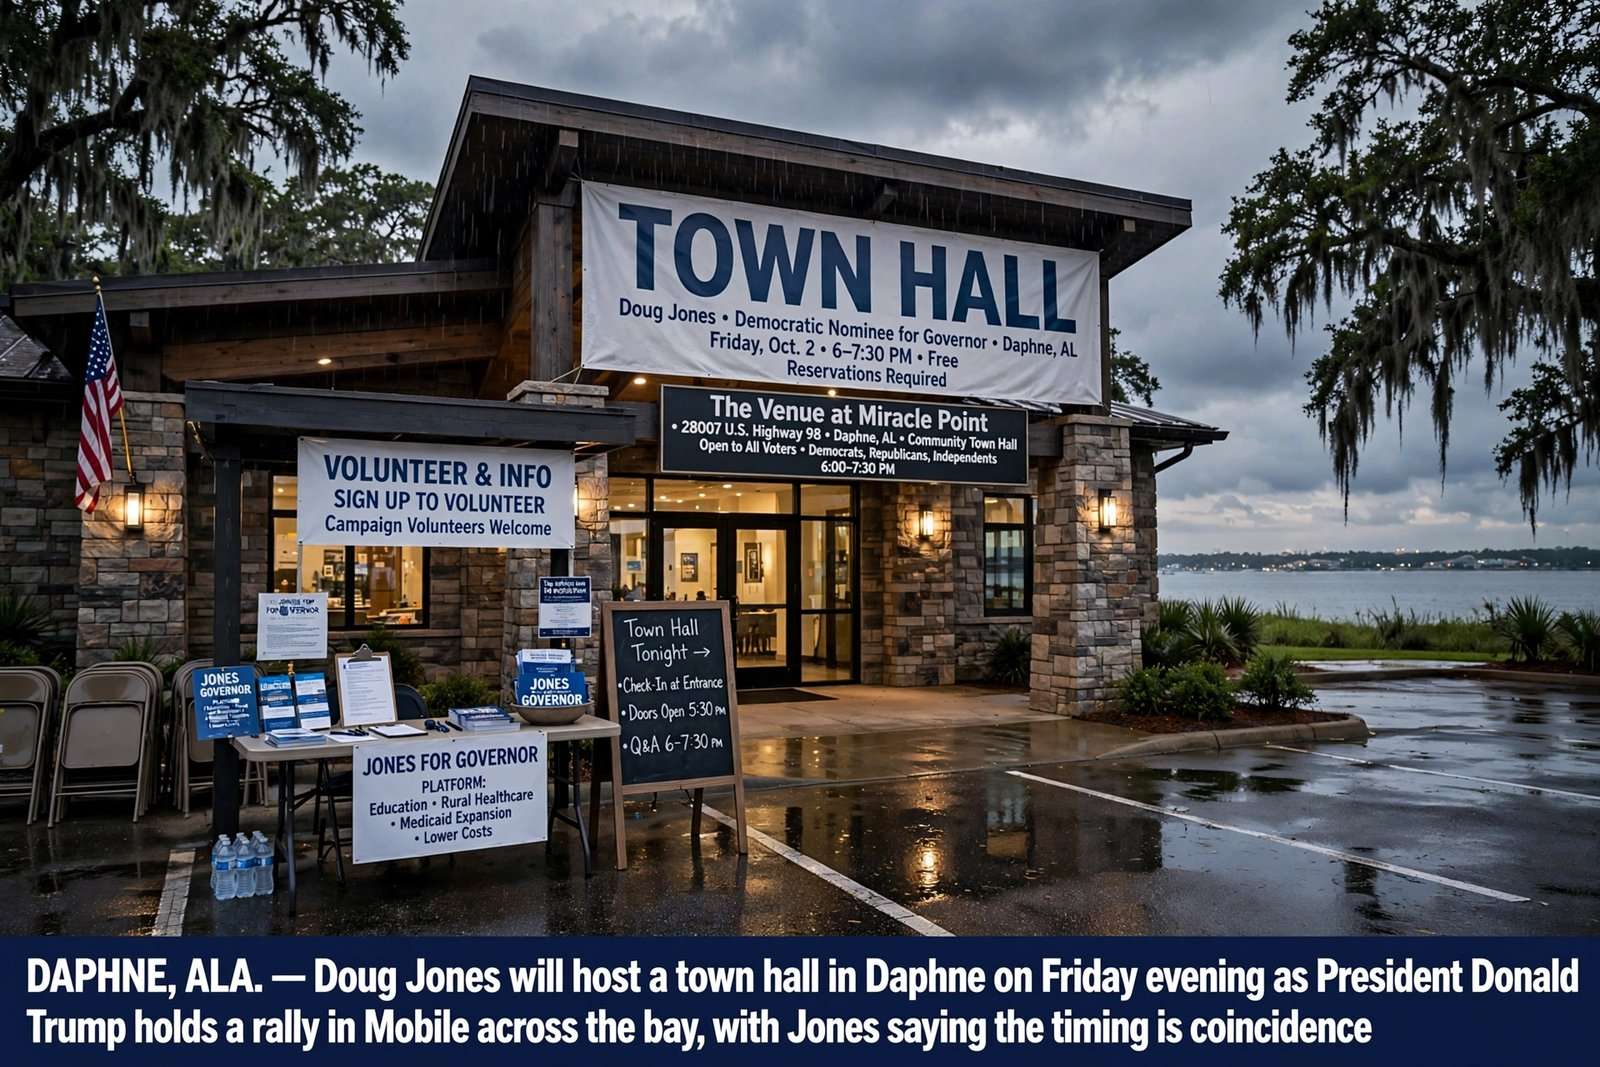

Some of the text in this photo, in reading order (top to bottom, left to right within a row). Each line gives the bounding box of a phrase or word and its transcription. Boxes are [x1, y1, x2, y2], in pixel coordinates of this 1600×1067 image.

[619, 202, 1076, 333] TOWN HALL
[619, 298, 1078, 358] Doug Jones Democratic Nominee for Governor Daphne, AL
[710, 331, 764, 355] Friday,
[769, 337, 800, 355] Oct.
[806, 340, 815, 356] 2
[889, 347, 912, 364] PM
[928, 350, 959, 368] Free
[787, 360, 947, 388] Reservations Required
[710, 394, 989, 433] The Venue at Miracle Point
[681, 420, 1017, 451] 28007 U.S. Highway 98 Daphne, AL Community Town Hall
[700, 438, 998, 465] Open to All Voters Democrats, Republicans, Independents
[324, 454, 551, 489] VOLUNTEER & INFO
[879, 463, 895, 475] PM
[334, 489, 545, 514] SIGN UP TO VOLUNTEER
[325, 514, 551, 536] Campaign Volunteers Welcome
[624, 617, 699, 638] Town Hall
[631, 643, 688, 668] Tonight
[200, 684, 252, 698] GOVERNOR
[201, 672, 240, 687] JONES
[530, 678, 570, 690] JONES
[623, 675, 723, 694] Check-In at Entrance
[522, 694, 583, 706] GOVERNOR
[629, 701, 726, 723] Doors Open 5:30 PM
[630, 735, 660, 757] Q&A
[711, 738, 723, 749] PM
[362, 746, 538, 776] JONES FOR GOVERNOR
[422, 775, 486, 794] PLATFORM:
[369, 790, 534, 816] Education Rural Healthcare
[400, 807, 512, 830] Medicaid Expansion
[424, 825, 493, 844] Lower Costs
